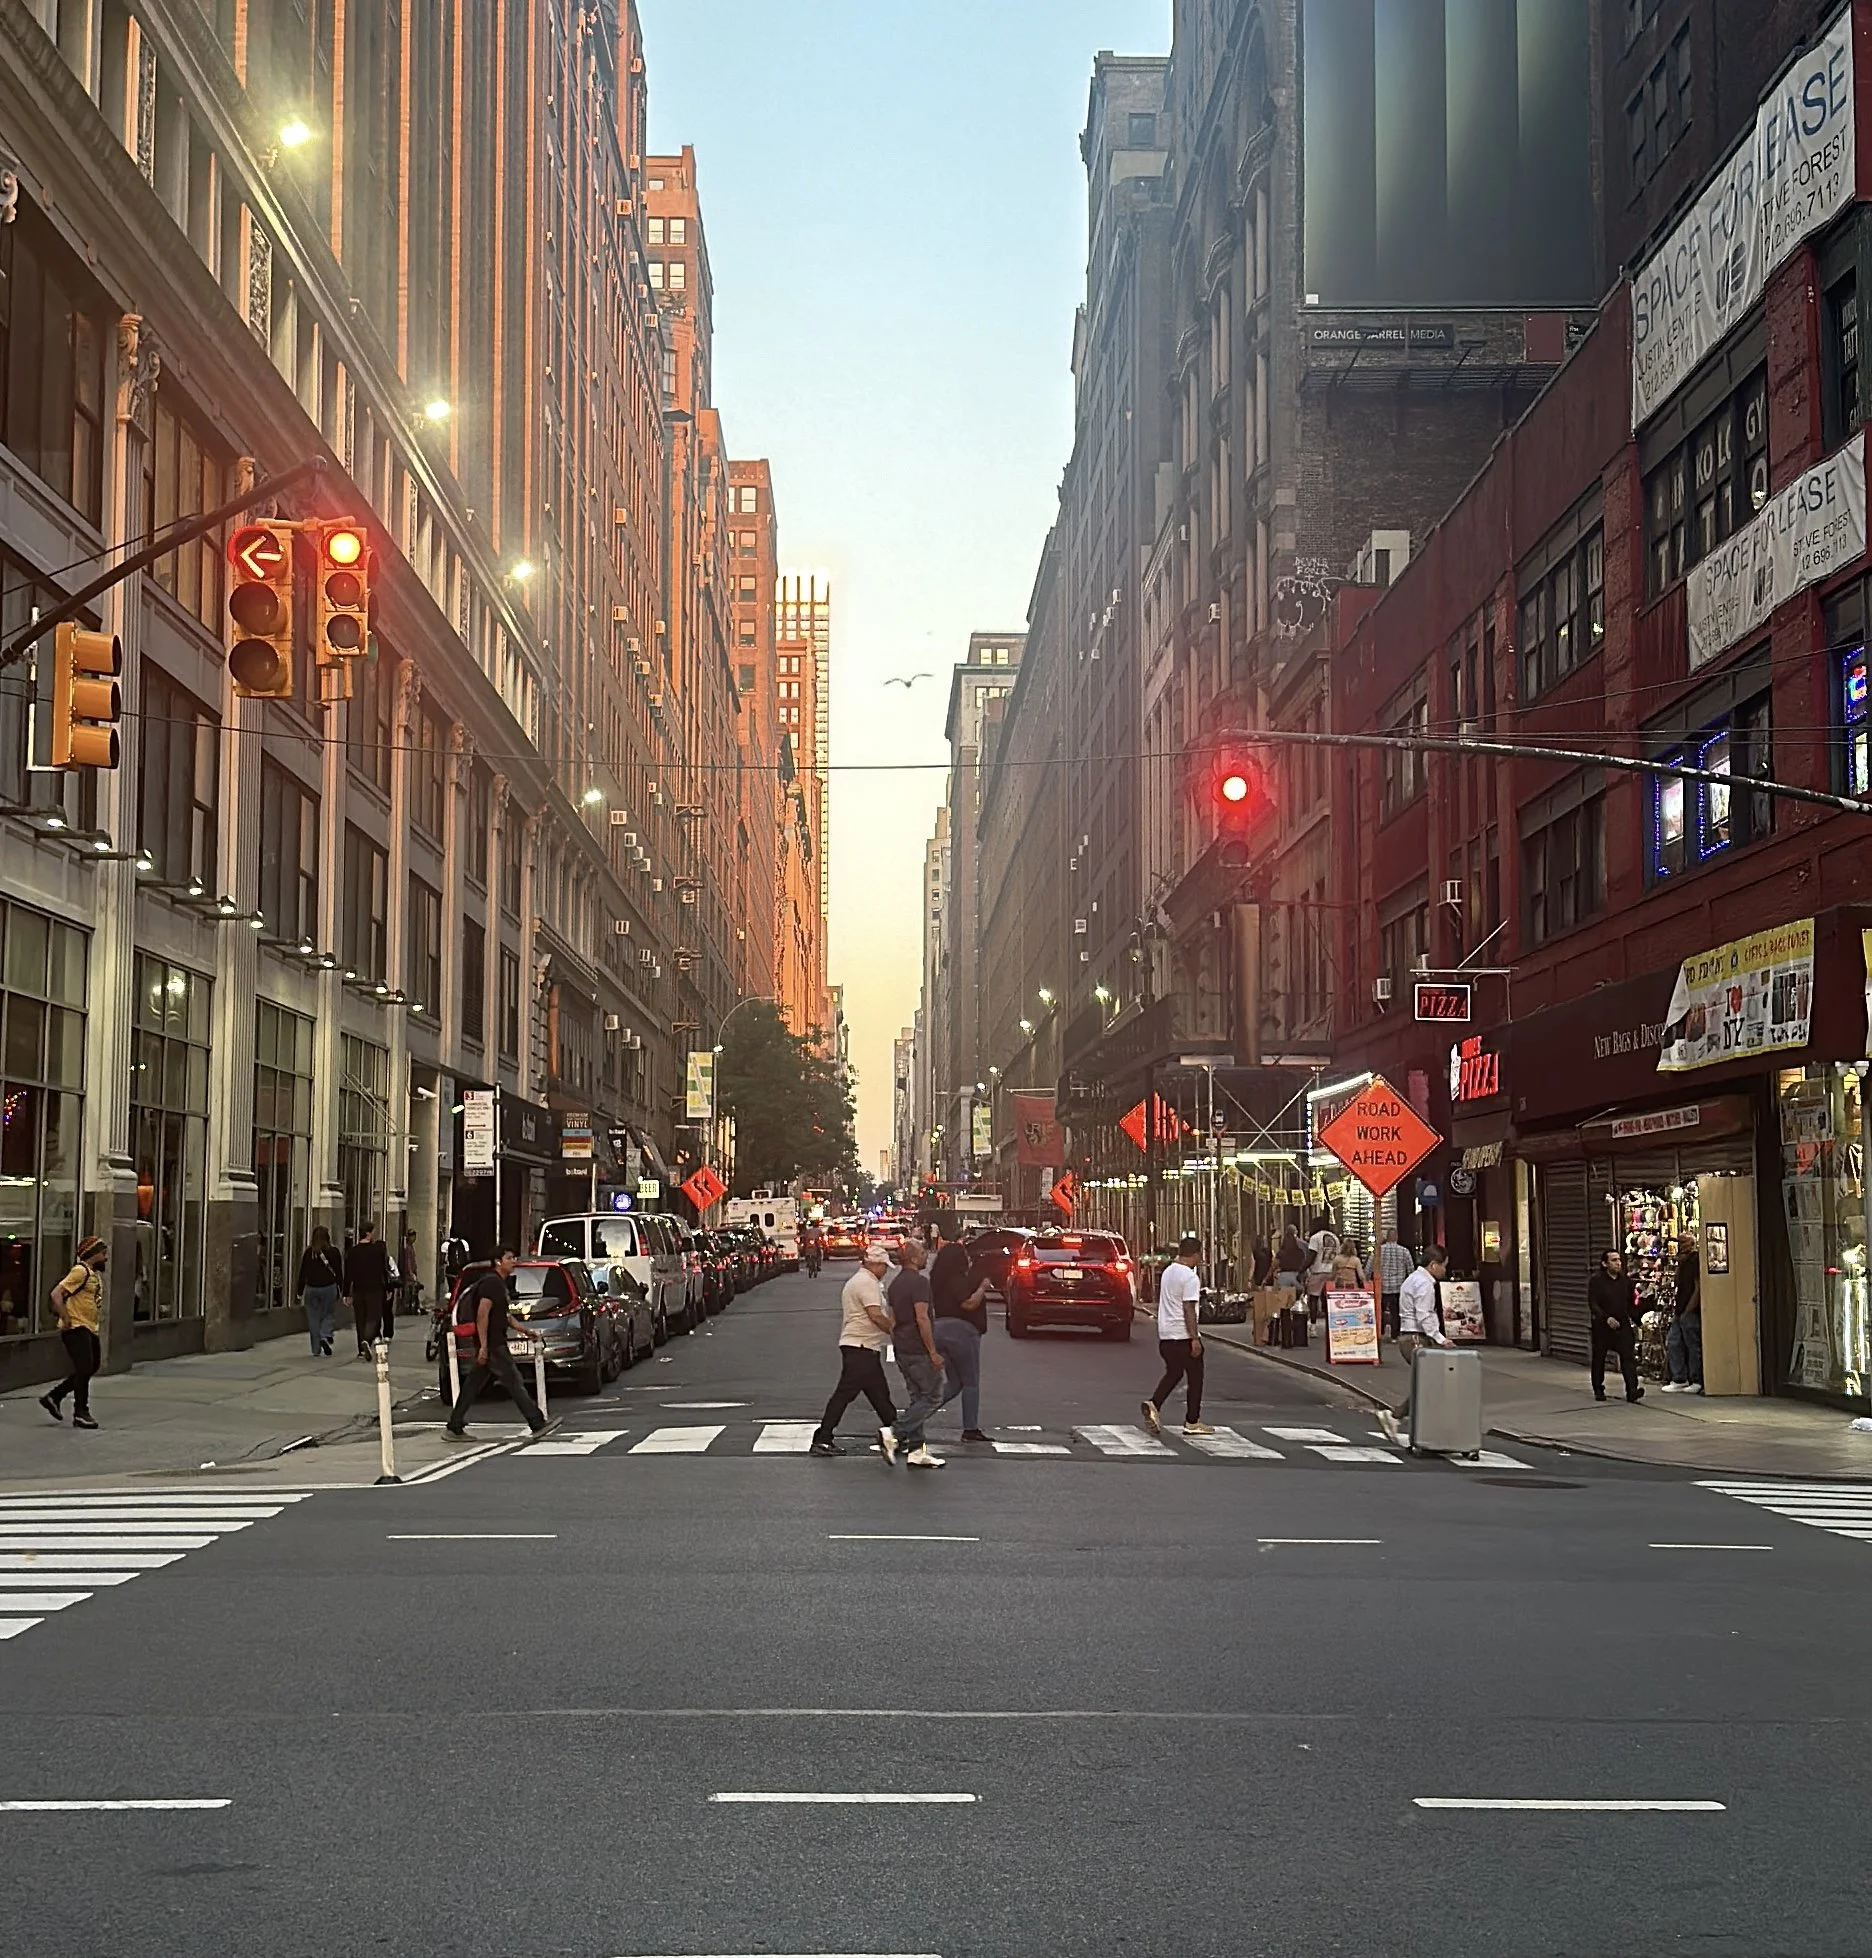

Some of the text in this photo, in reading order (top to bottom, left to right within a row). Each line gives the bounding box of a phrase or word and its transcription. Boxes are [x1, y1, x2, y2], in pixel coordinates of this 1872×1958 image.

[1791, 125, 1847, 193] FOREST
[1635, 223, 1702, 344] SPACE
[1708, 160, 1755, 262] FOR
[1758, 44, 1847, 184] EASE
[1314, 329, 1446, 340] ORANGE ARREL MEDIA
[1706, 466, 1836, 597] SPACE FOR LEASE
[1420, 995, 1467, 1017] PIZZA
[1460, 1052, 1500, 1102] PIZZA
[1357, 1102, 1401, 1117] ROAD
[1357, 1126, 1402, 1141] WORK
[1351, 1150, 1408, 1166] AHEAD
